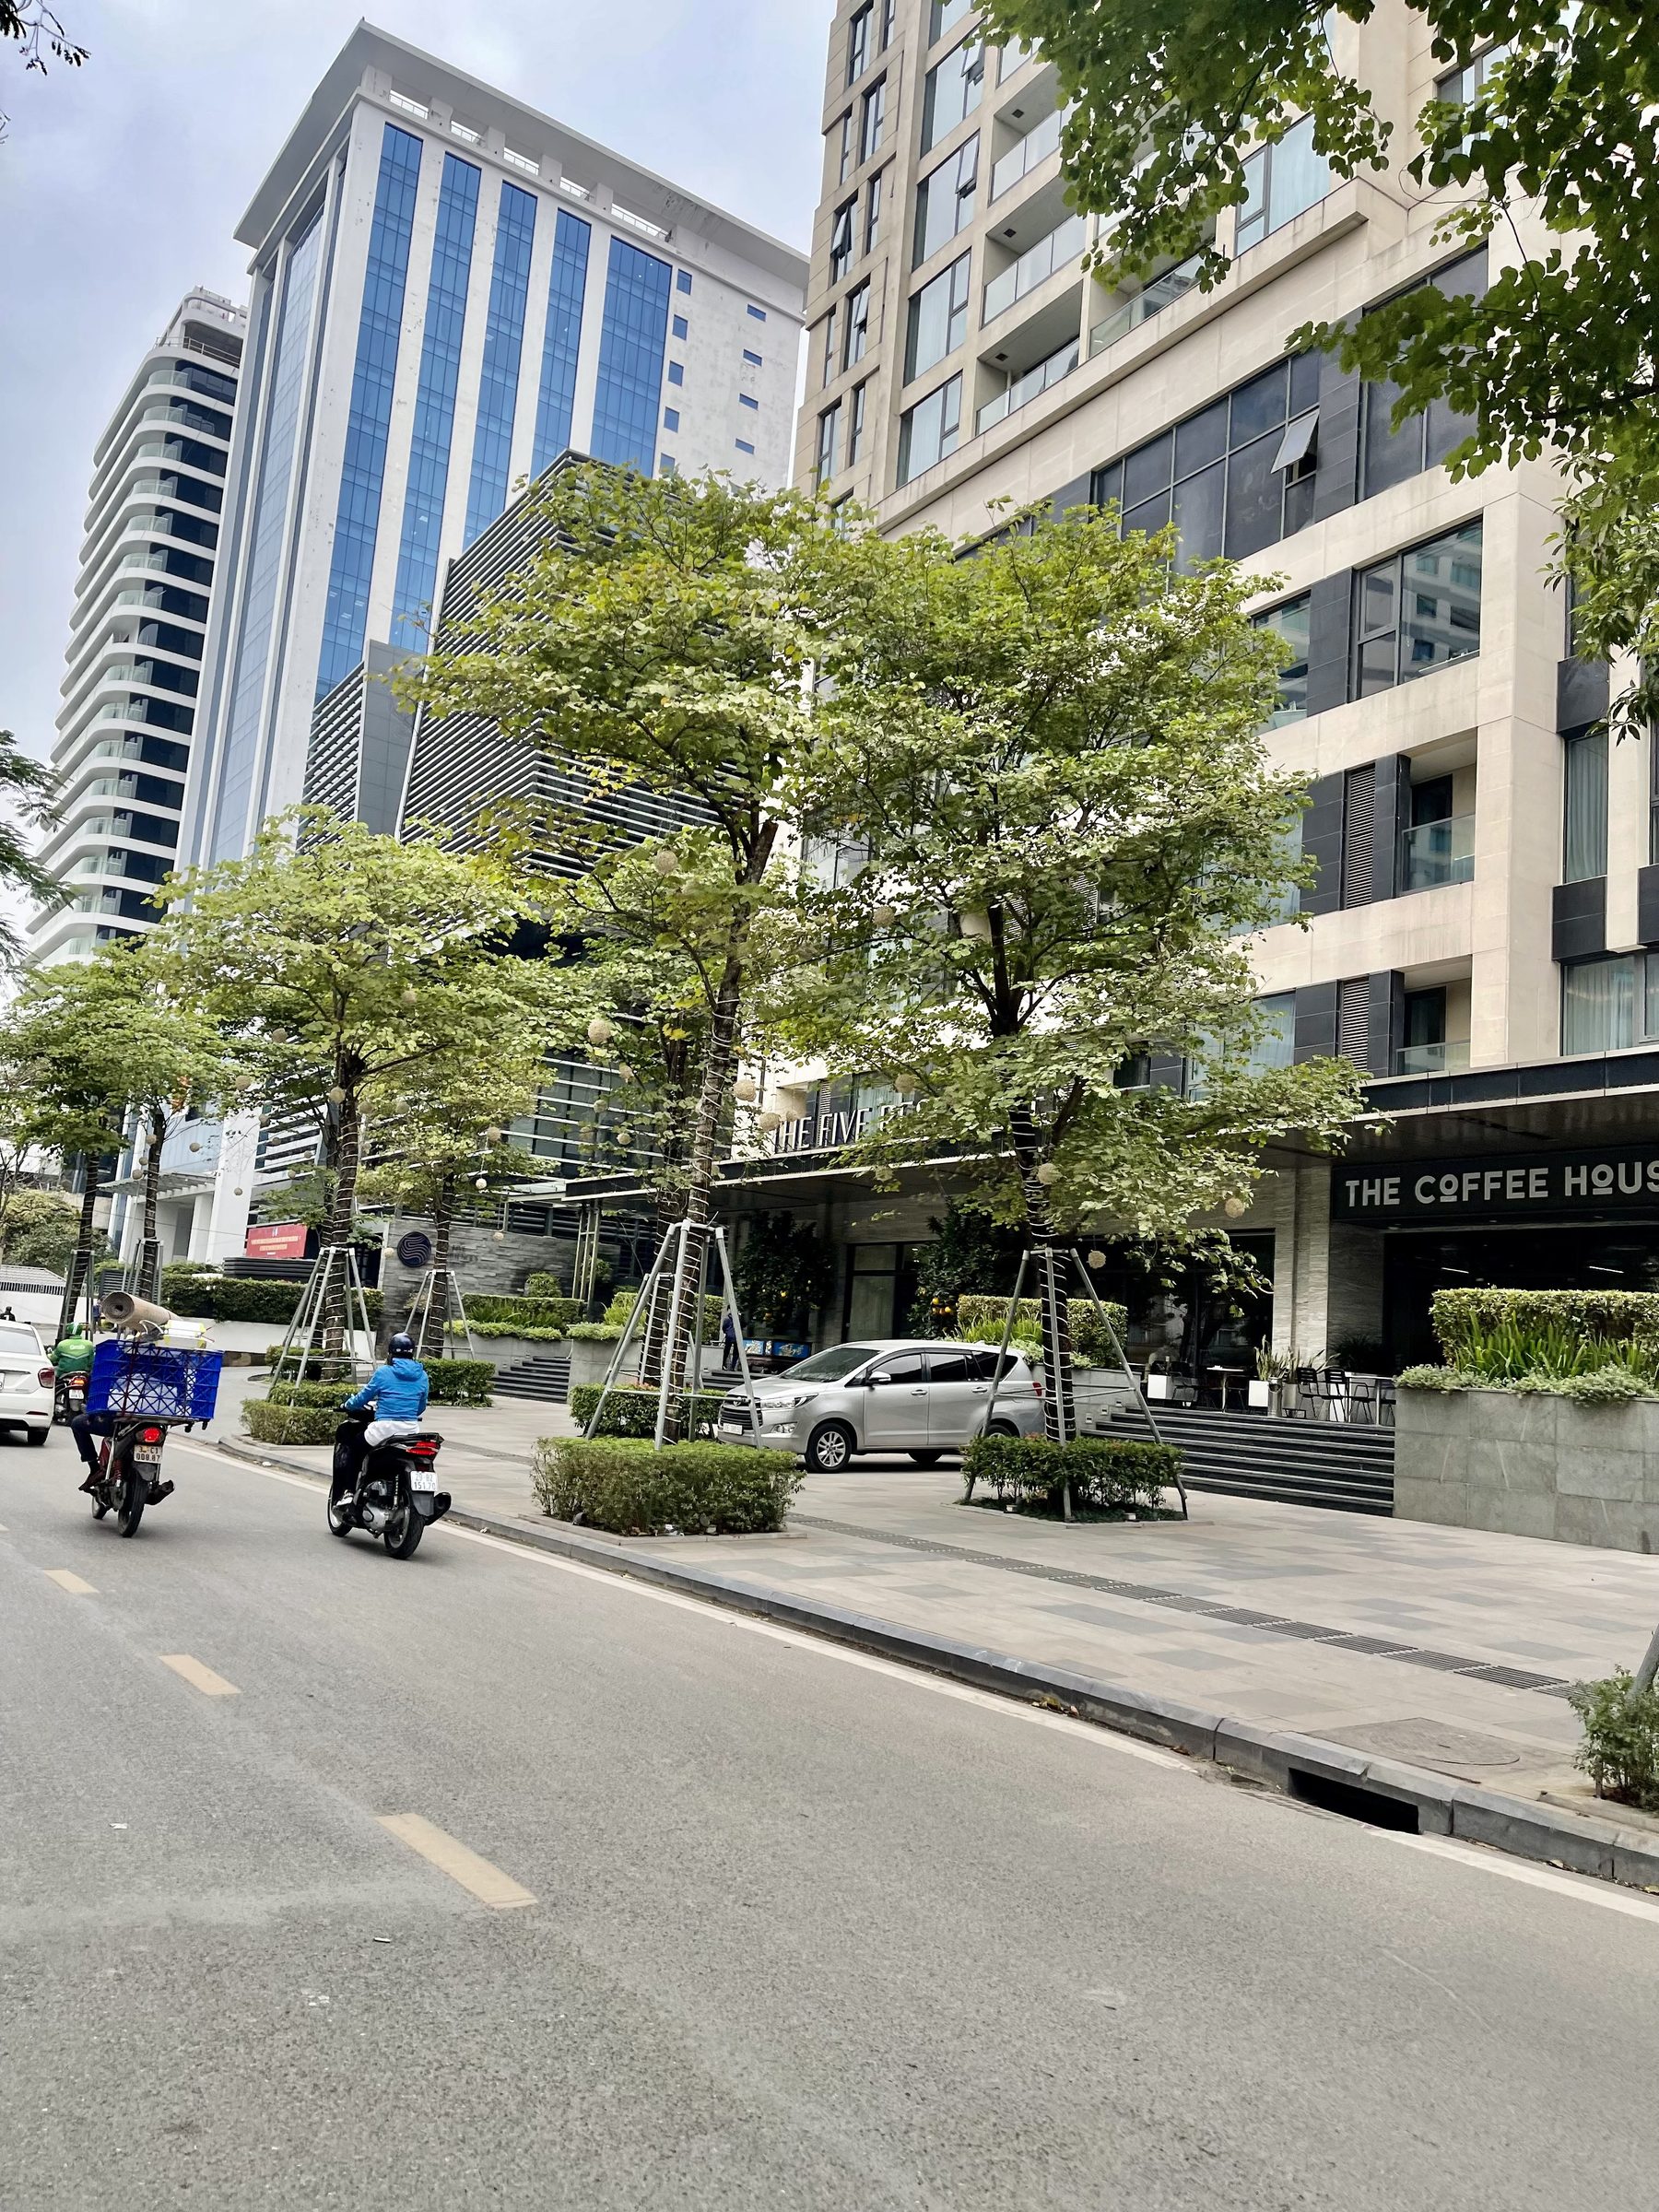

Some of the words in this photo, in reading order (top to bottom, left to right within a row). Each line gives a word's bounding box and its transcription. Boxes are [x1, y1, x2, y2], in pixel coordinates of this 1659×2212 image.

[818, 1107, 872, 1147] FIVE
[1346, 1177, 1401, 1207] THE
[1415, 1168, 1549, 1205] COFFEE
